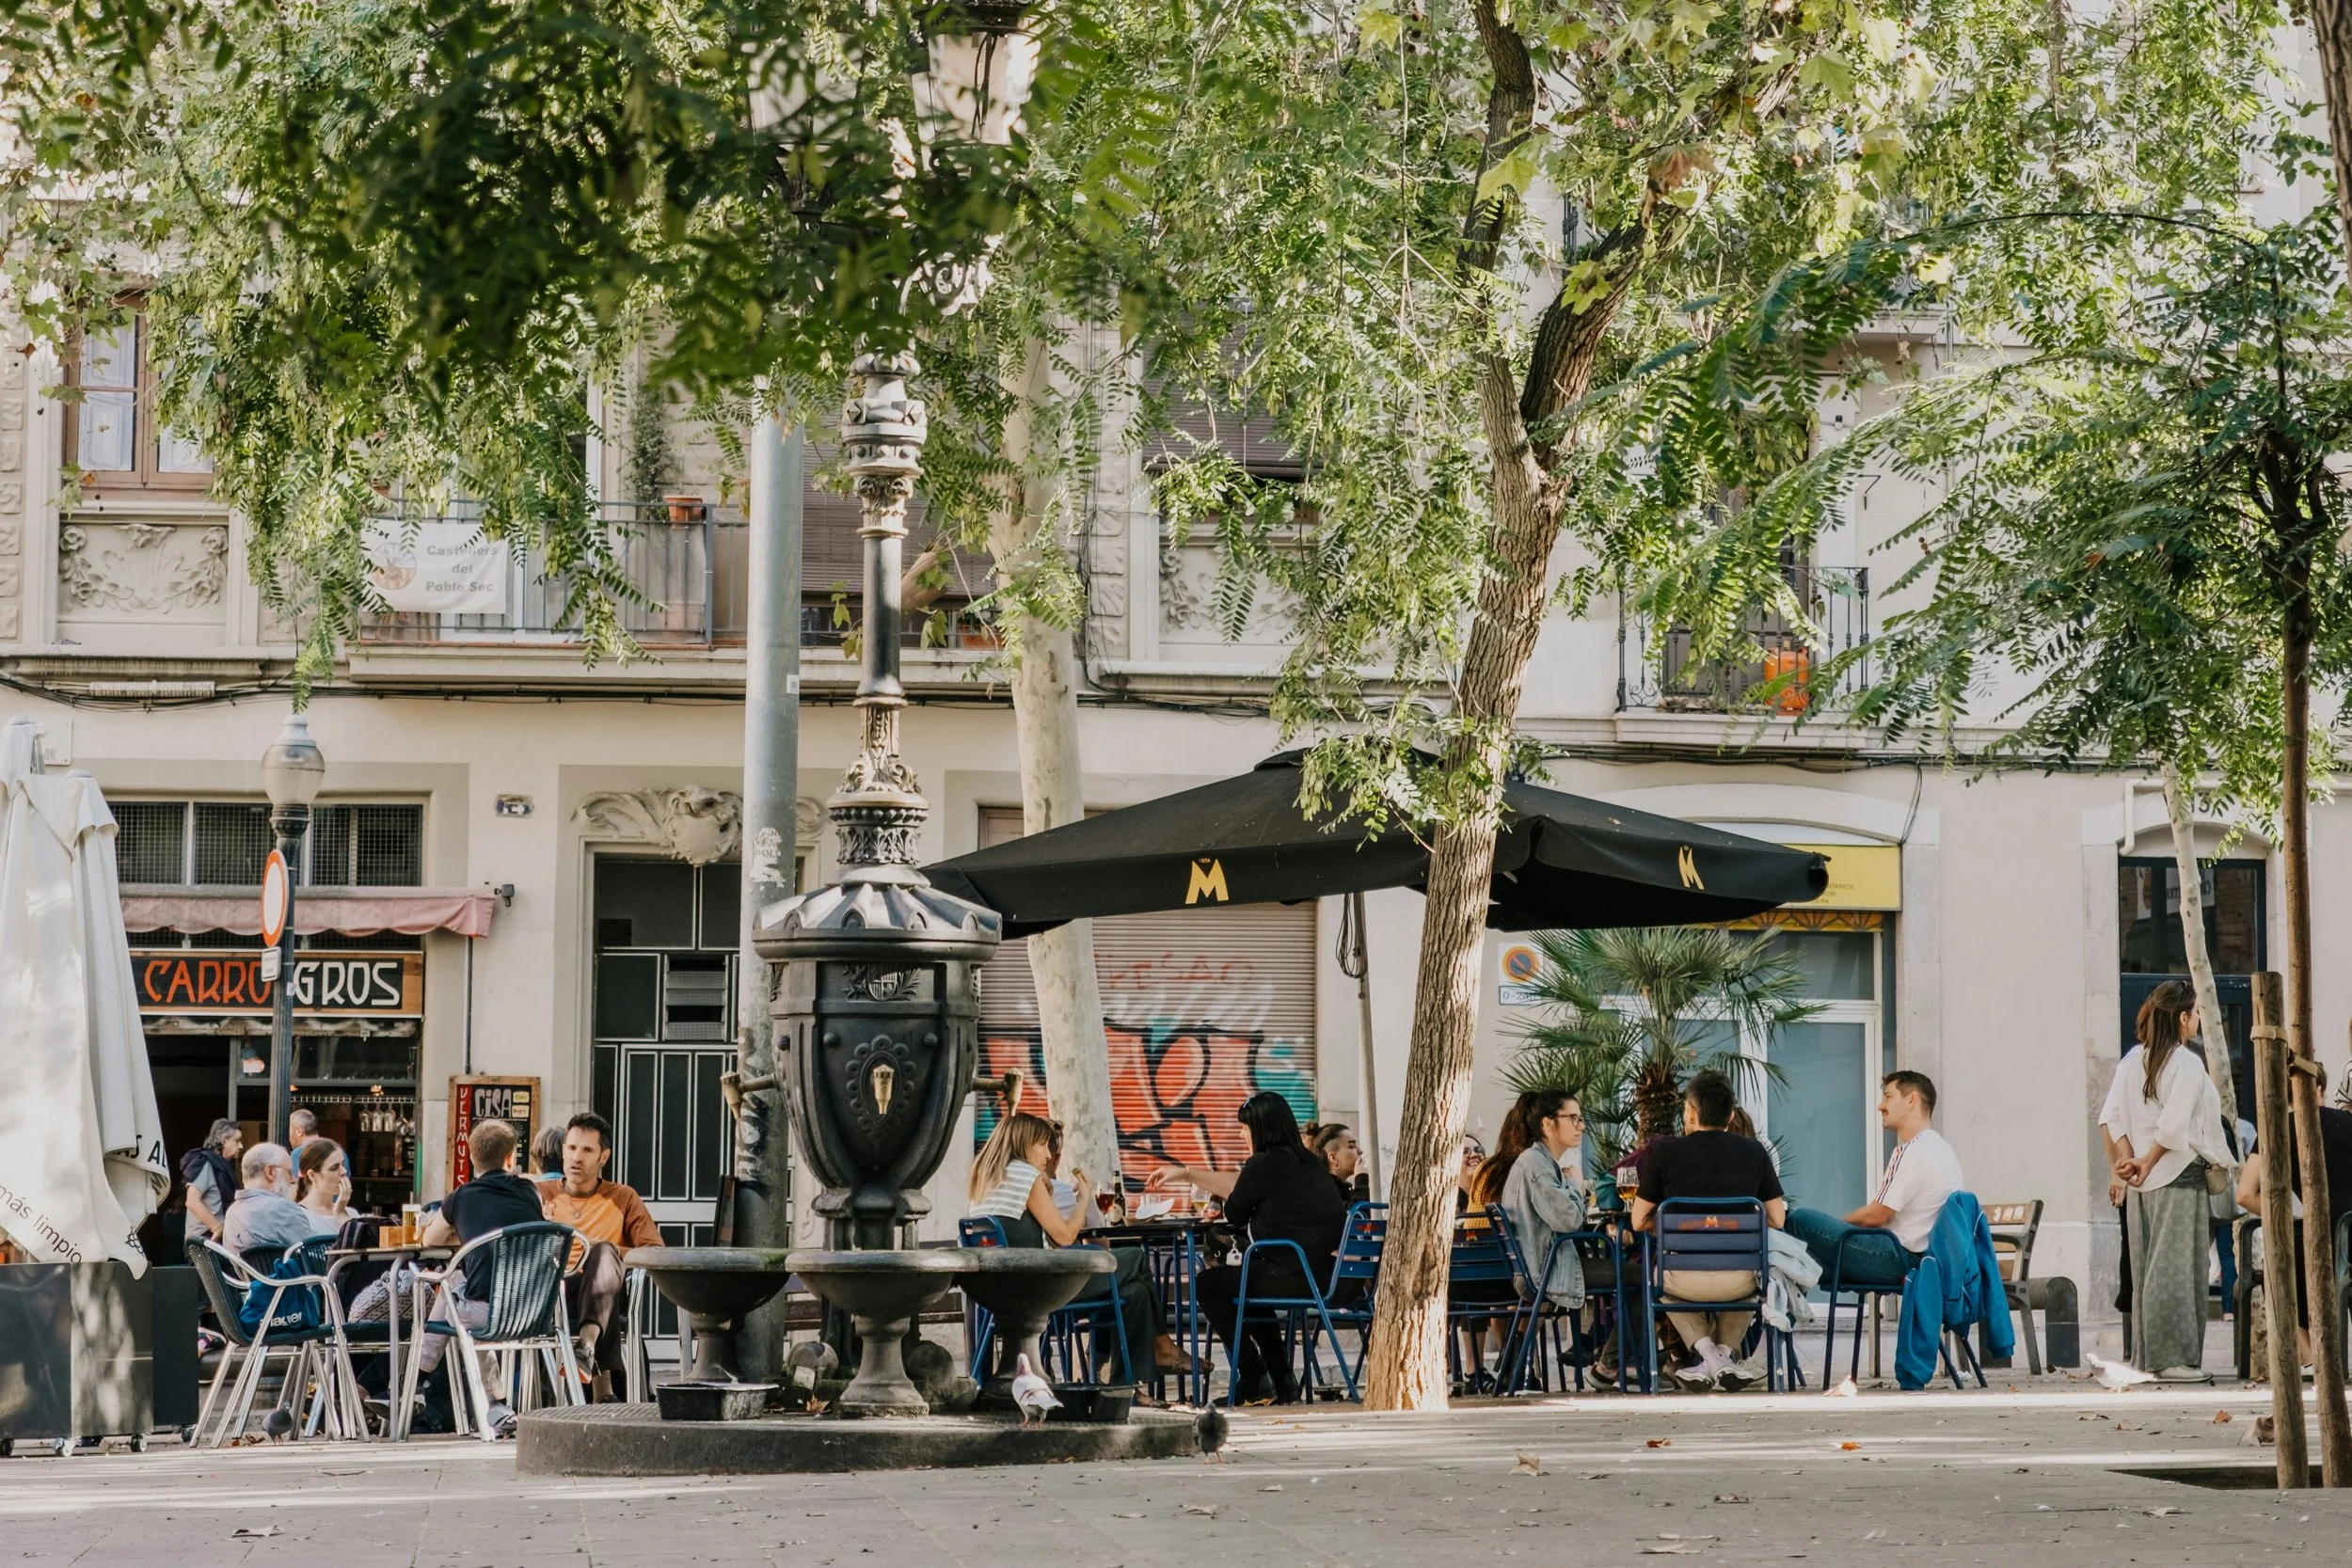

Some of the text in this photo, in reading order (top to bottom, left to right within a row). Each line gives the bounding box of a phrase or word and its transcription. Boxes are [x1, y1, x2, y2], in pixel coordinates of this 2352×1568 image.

[425, 581, 494, 592] Poble Sec
[452, 563, 473, 574] del
[1185, 858, 1229, 904] M
[144, 960, 272, 1005] CARRO
[294, 961, 401, 1006] GROS
[33, 1213, 82, 1263] limpio
